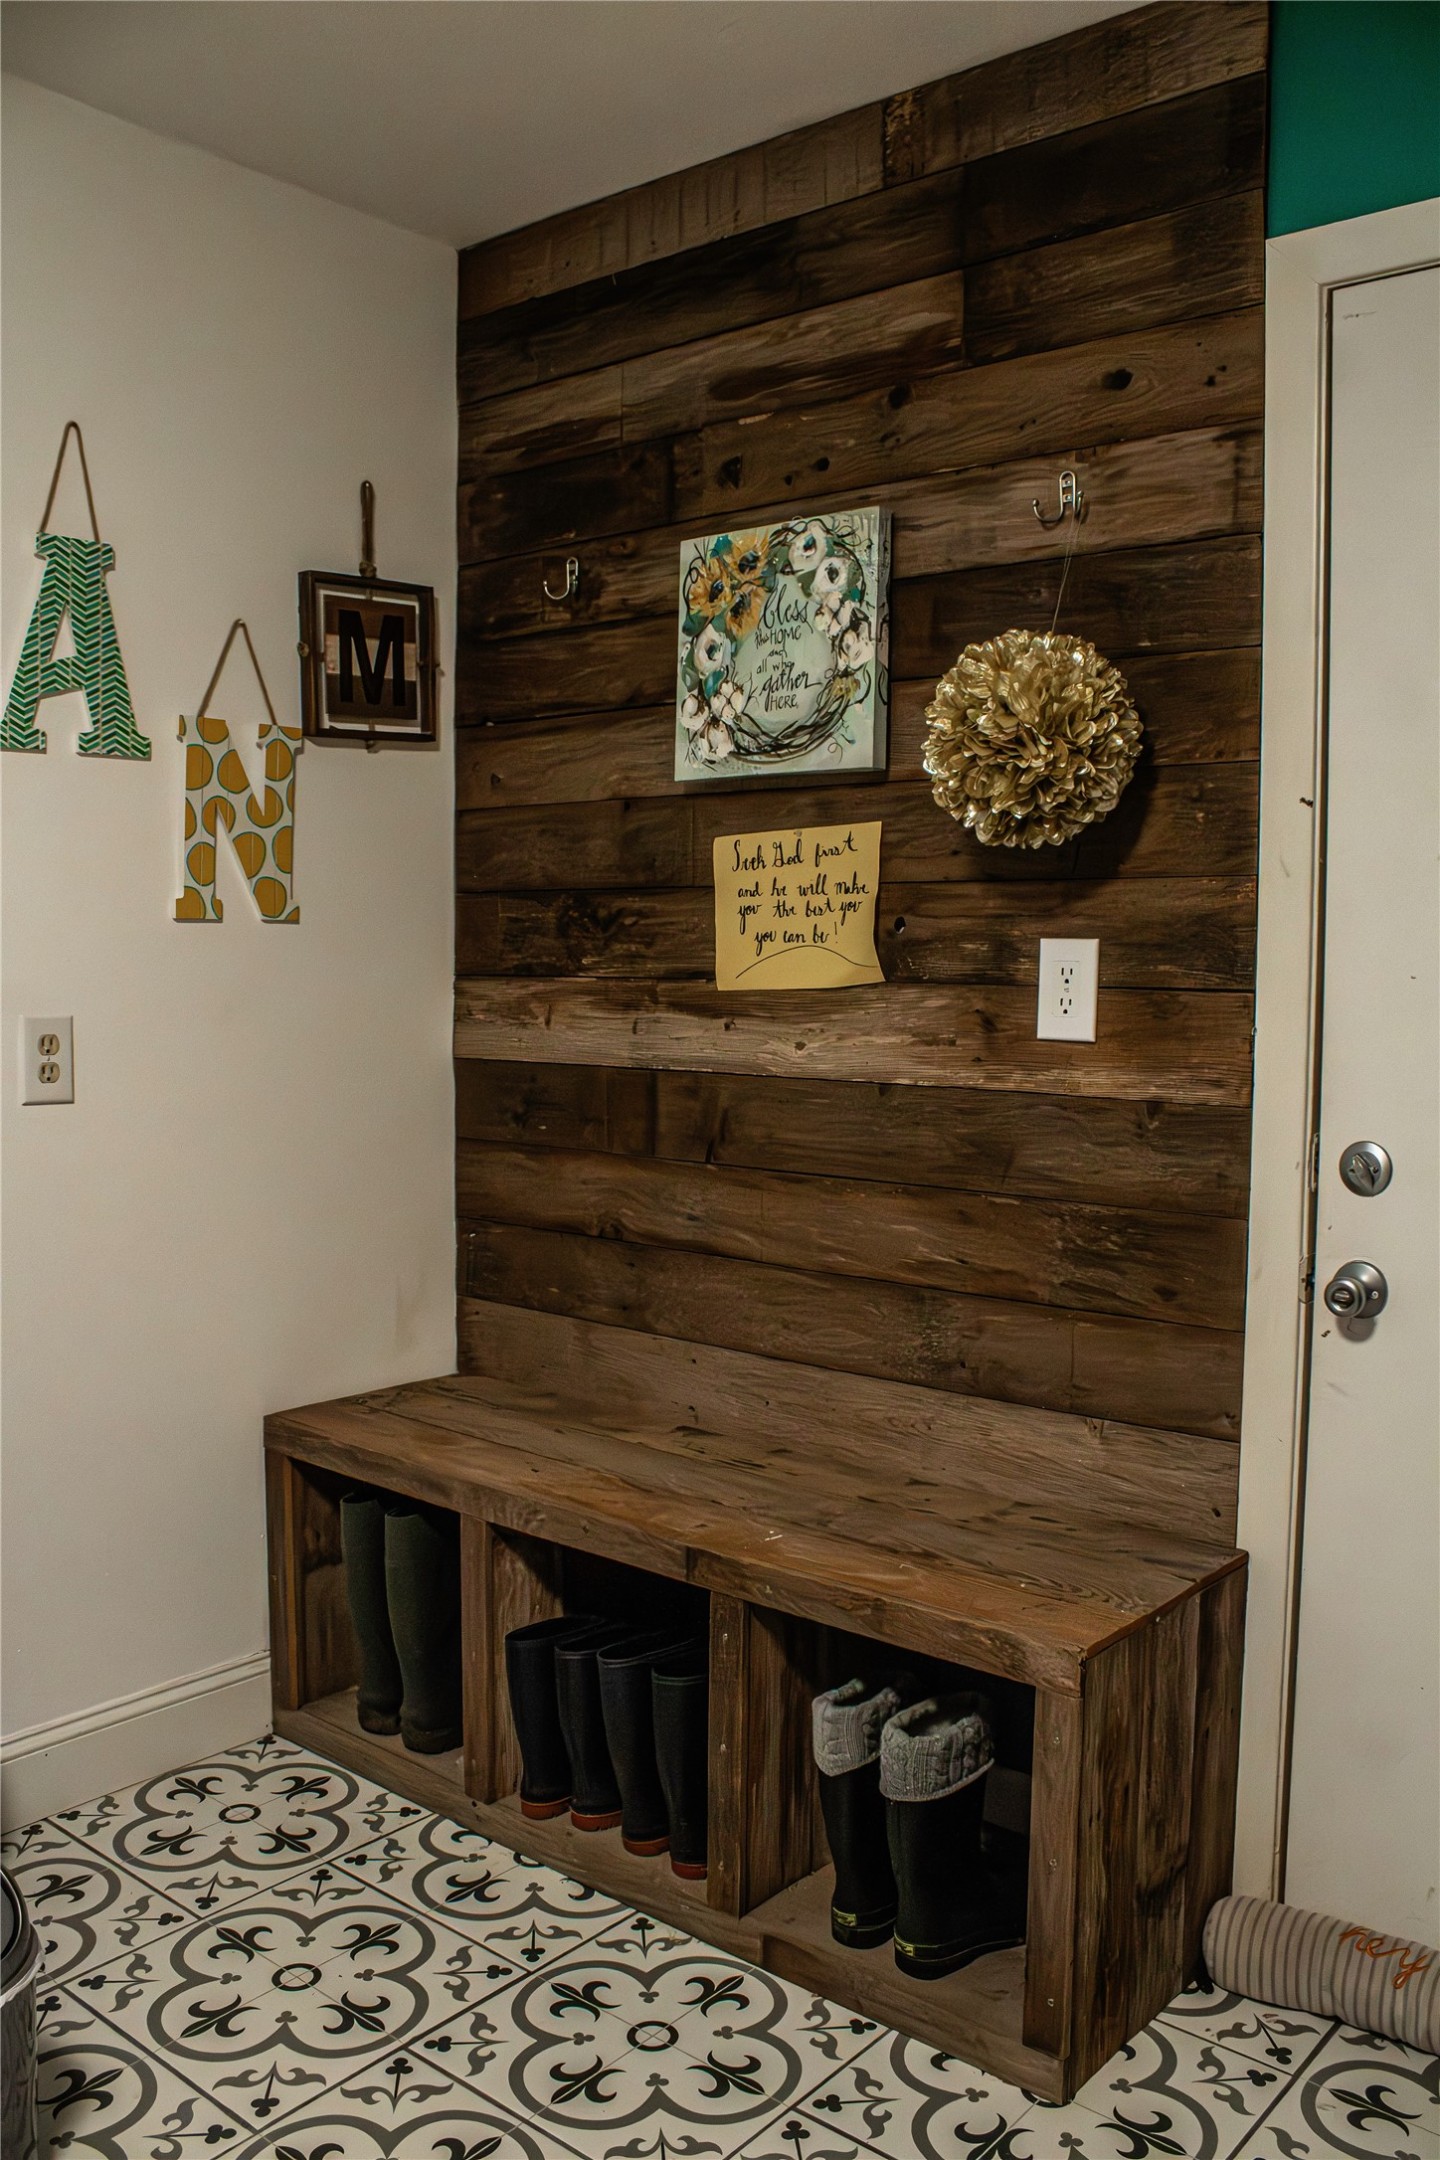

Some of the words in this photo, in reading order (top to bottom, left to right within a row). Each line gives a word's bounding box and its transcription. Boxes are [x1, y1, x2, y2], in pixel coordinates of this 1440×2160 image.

[757, 583, 814, 634] bless
[0, 532, 152, 759] A
[338, 608, 406, 707] M
[756, 658, 768, 674] all
[772, 656, 795, 672] who
[758, 663, 823, 712] gather
[173, 714, 303, 922] N
[732, 839, 767, 872] Seek
[772, 838, 804, 868] God
[815, 830, 858, 867] first
[737, 881, 764, 898] and
[770, 876, 788, 897] he
[797, 873, 827, 897] will
[834, 871, 870, 895] make
[736, 904, 763, 935] you
[772, 899, 797, 919] the
[805, 897, 836, 918] best
[838, 900, 863, 926] you
[754, 931, 777, 957] you
[783, 930, 806, 944] can
